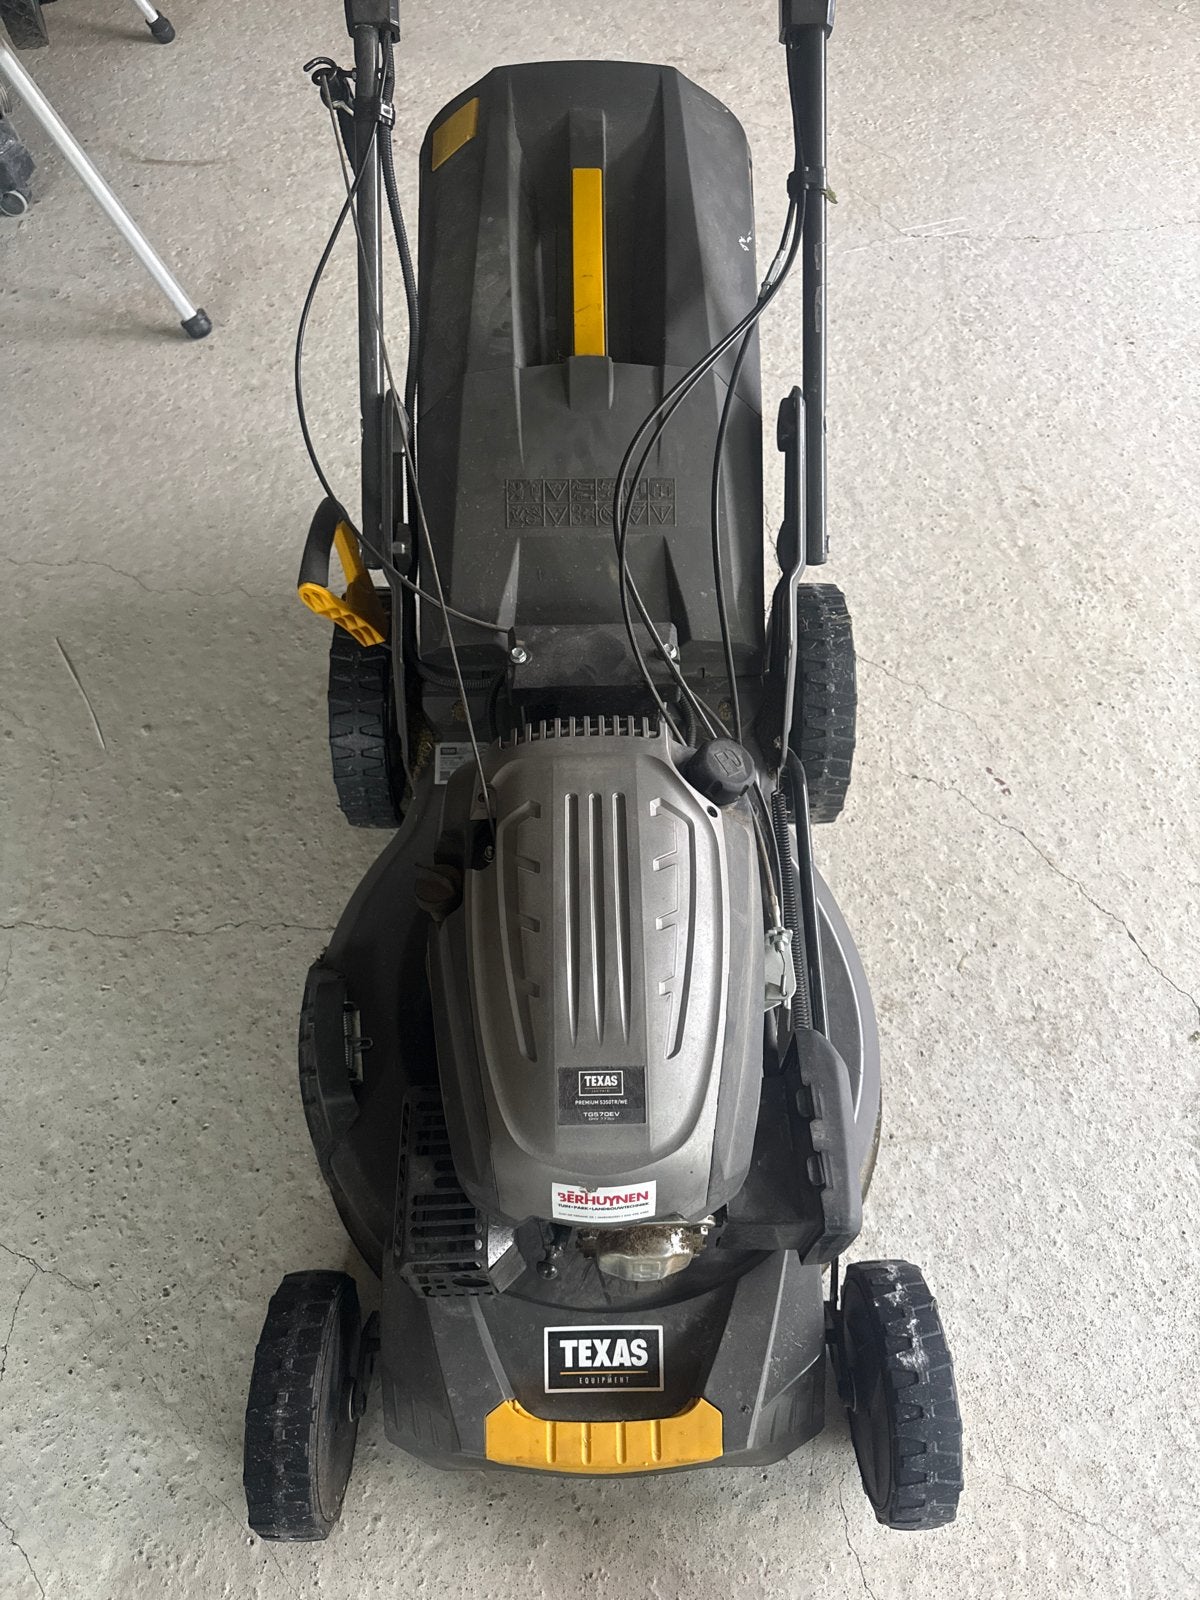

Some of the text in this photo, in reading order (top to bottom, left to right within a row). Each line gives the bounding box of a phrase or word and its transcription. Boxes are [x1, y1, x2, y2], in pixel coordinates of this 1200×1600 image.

[584, 1075, 618, 1086] TEXAS
[559, 1338, 648, 1368] TEXAS
[579, 1376, 630, 1385] EQUIPMENT
